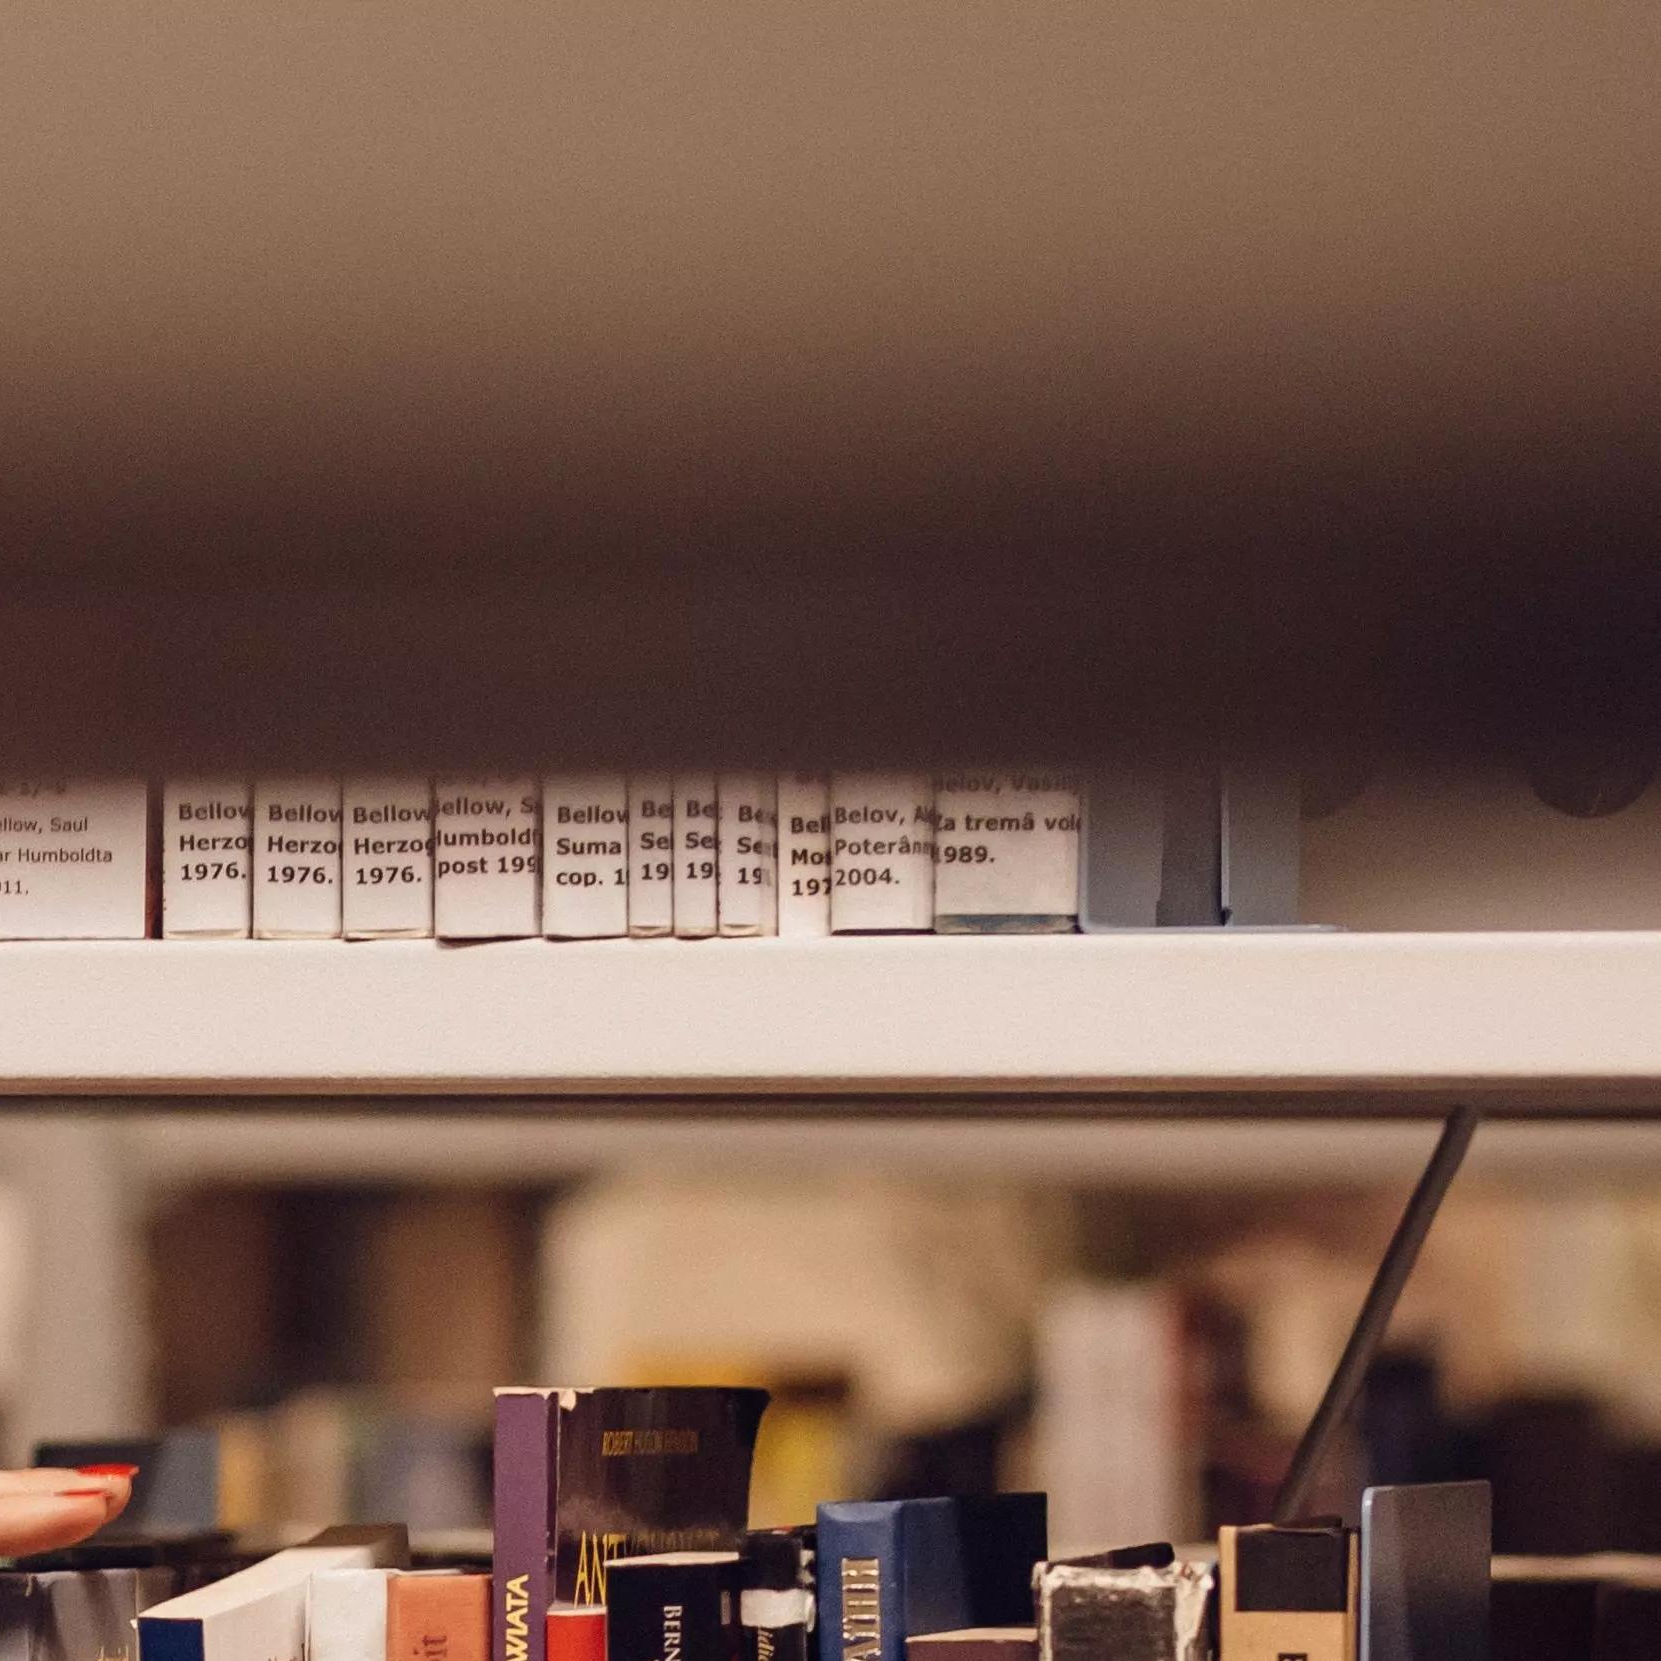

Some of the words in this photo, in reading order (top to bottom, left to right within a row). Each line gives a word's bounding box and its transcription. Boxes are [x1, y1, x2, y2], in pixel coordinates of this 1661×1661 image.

[17, 847, 114, 864] Humboldta
[556, 838, 622, 855] Suma
[181, 862, 247, 881] 1976.
[267, 865, 333, 885] 1976.
[355, 866, 422, 885] 1976.
[438, 858, 489, 879] post
[835, 868, 900, 886] 2004.
[556, 871, 604, 887] cop.
